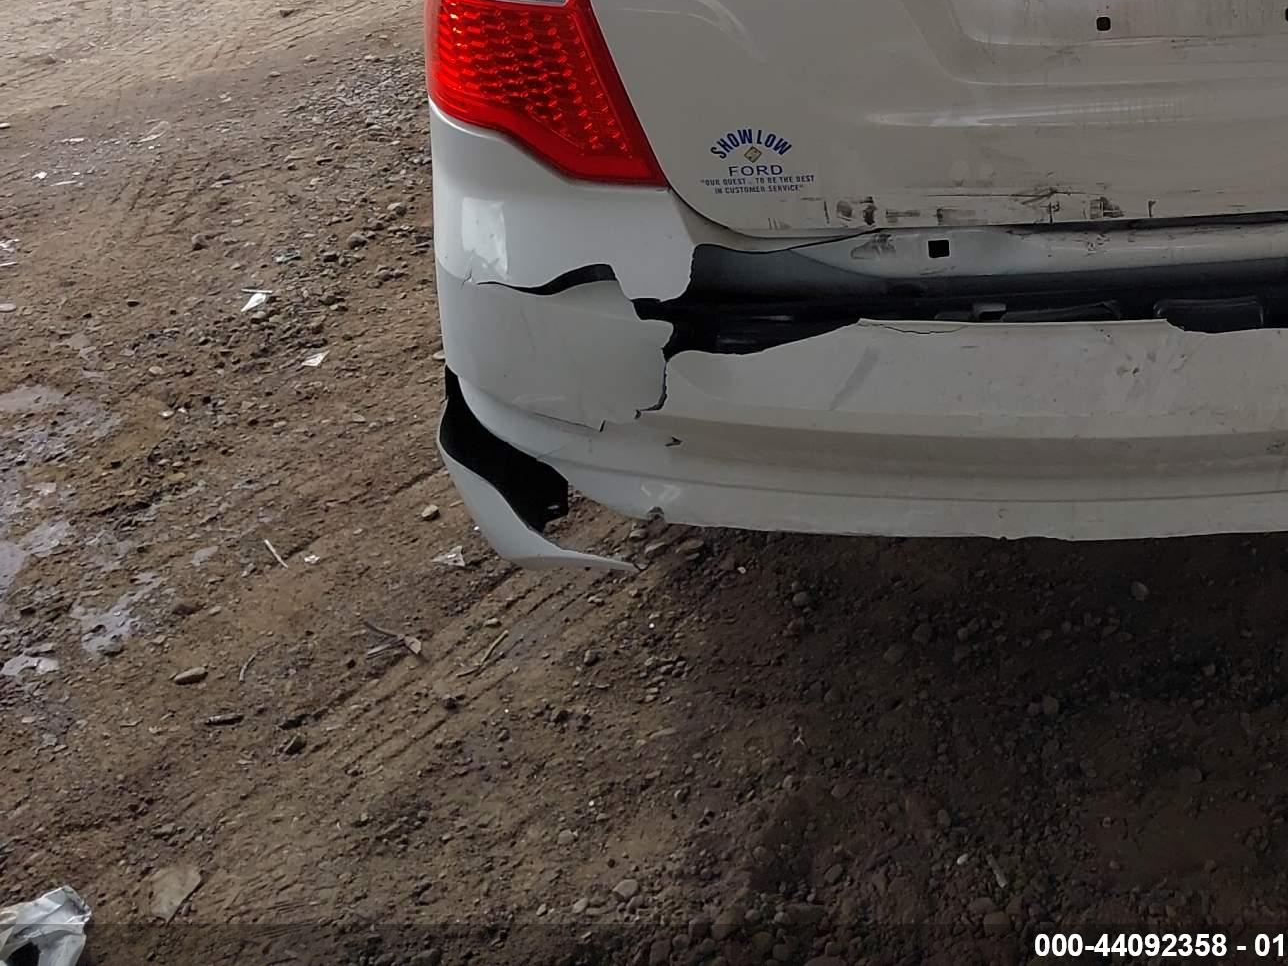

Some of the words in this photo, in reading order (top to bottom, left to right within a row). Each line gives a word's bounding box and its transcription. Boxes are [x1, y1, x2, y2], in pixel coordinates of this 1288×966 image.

[710, 128, 753, 160] SHOW
[756, 129, 793, 156] LOW
[728, 164, 783, 177] FORD
[722, 178, 746, 186] QUEST
[767, 176, 778, 185] BE
[779, 176, 794, 184] THE
[796, 174, 815, 183] BEST
[725, 185, 766, 194] CUSTOMER
